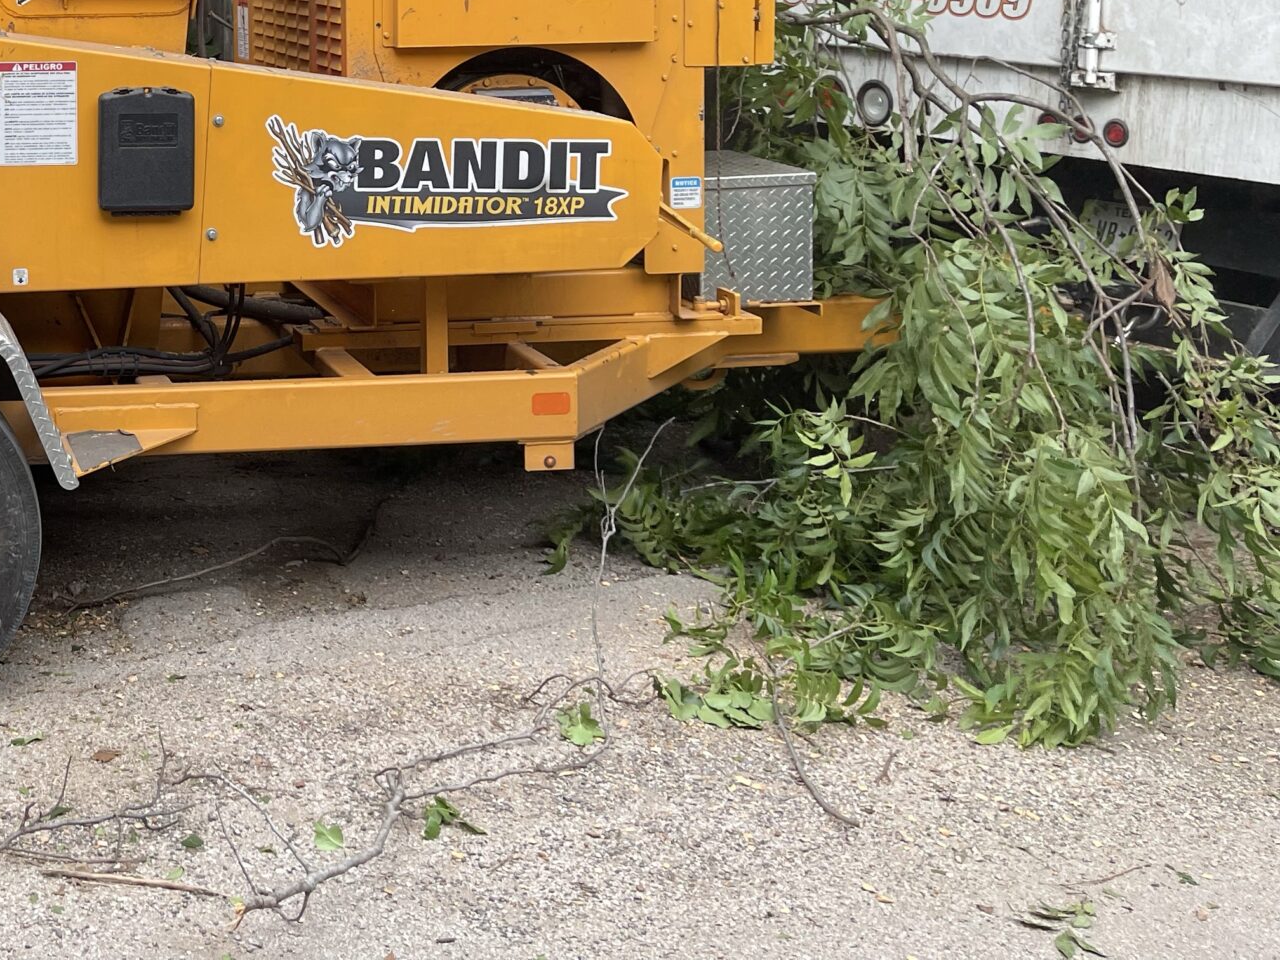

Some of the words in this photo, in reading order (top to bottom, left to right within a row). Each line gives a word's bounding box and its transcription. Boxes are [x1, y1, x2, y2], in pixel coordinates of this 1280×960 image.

[23, 63, 63, 71] PELIGRO
[356, 139, 609, 190] BANDIT
[534, 197, 586, 216] 18XP
